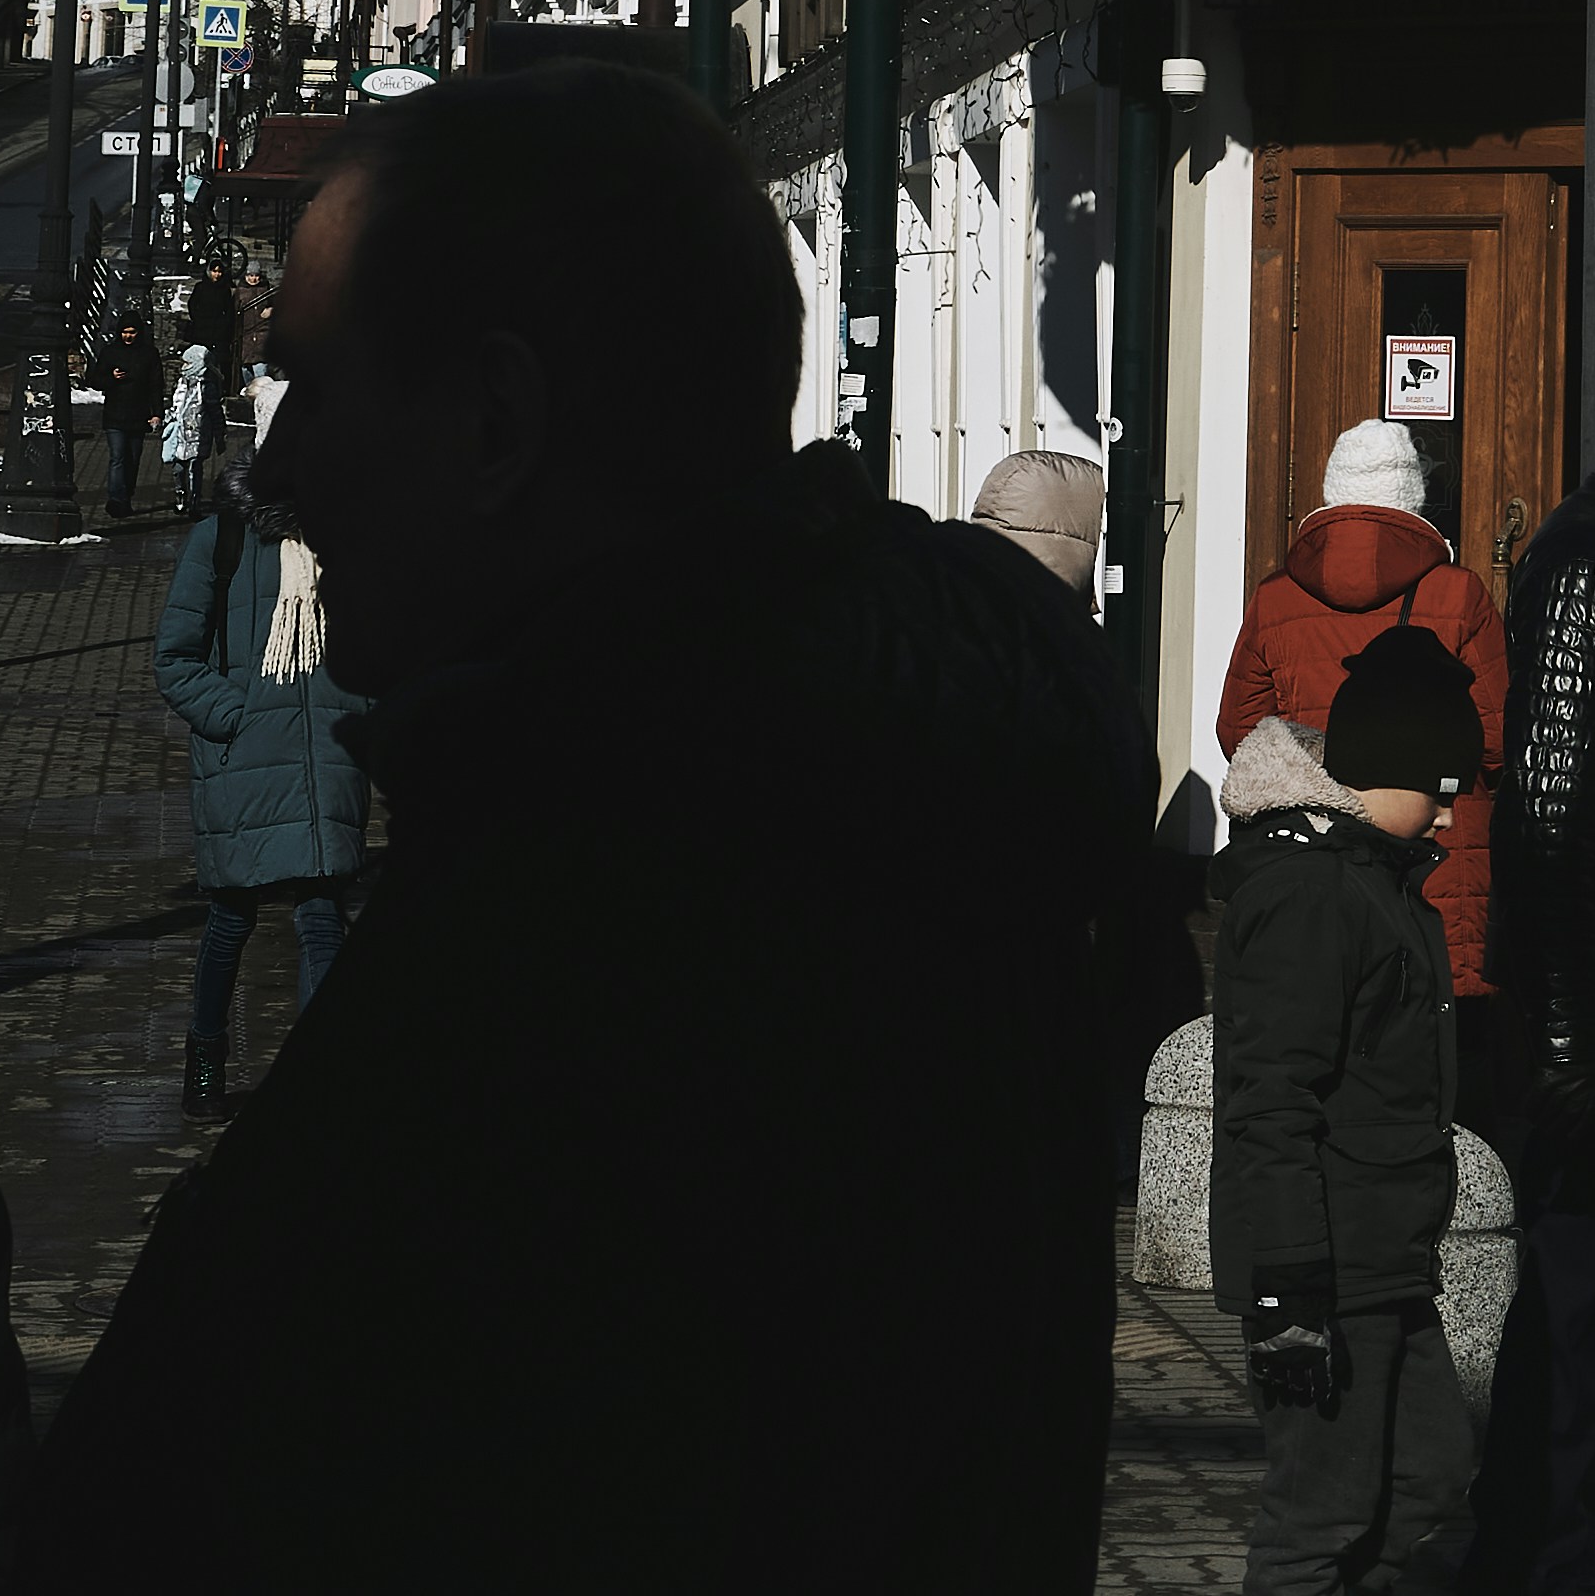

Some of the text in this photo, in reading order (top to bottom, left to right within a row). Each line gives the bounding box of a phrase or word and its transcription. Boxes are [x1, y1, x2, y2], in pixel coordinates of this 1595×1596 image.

[371, 75, 402, 91] Coffee
[112, 136, 161, 152] СТП
[1392, 342, 1450, 353] ВНИМАНИЕ!
